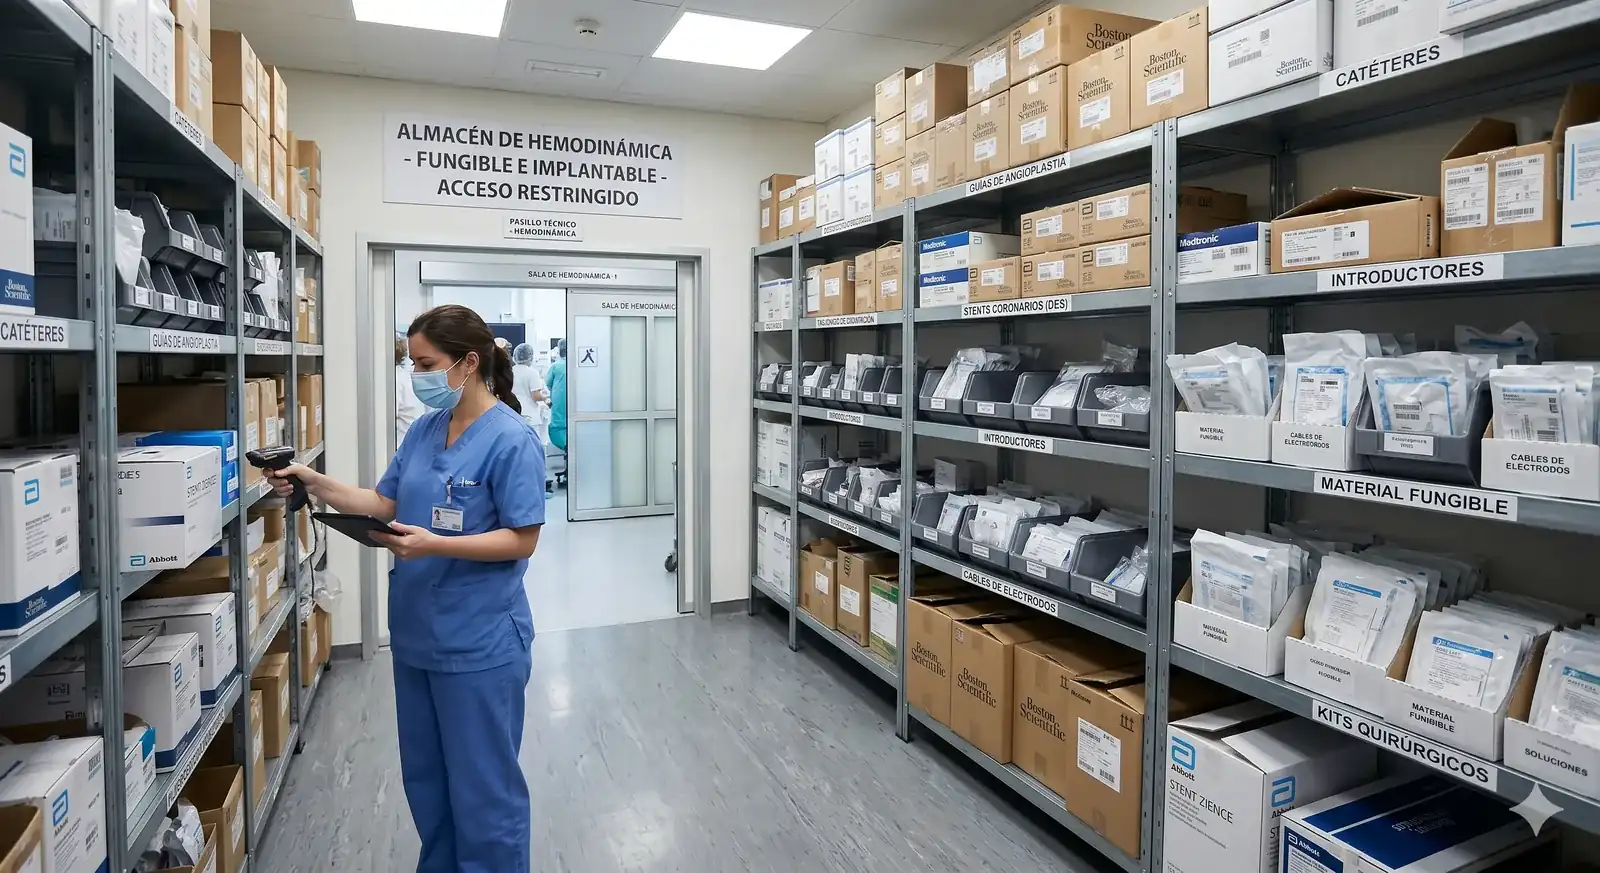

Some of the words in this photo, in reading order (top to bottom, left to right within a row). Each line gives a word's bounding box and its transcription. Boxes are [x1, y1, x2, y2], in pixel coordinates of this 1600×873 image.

[1143, 52, 1187, 78] Scientific
[1149, 49, 1177, 66] Boston
[1280, 57, 1303, 69] Boston
[1335, 44, 1441, 88] CATÉTERES
[1275, 59, 1313, 77] Scientific
[1077, 82, 1114, 102] Scientific
[1082, 76, 1106, 92] Boston
[1022, 99, 1042, 112] Boston
[397, 123, 493, 147] ALMACÉN
[499, 130, 523, 149] DE
[528, 133, 673, 161] HEMODINÁMICA
[417, 150, 513, 174] FUNGIBLE
[518, 158, 527, 175] E
[533, 159, 657, 184] IMPLANTABLE
[993, 175, 1004, 187] DE
[1005, 157, 1067, 183] ANGIOPLASTIA
[437, 178, 513, 200] ACCESO
[517, 184, 640, 207] RESTRINGIDO
[509, 218, 542, 227] PASILLO
[543, 218, 577, 228] TÉCNICO
[514, 228, 577, 237] HEMODINÁMICA
[528, 270, 546, 278] SALA
[1331, 260, 1485, 288] INTRODUCTORES
[630, 302, 676, 310] HEMODINÁMIC
[963, 304, 991, 317] STENTS
[992, 301, 1044, 314] CORONARIOS
[1045, 298, 1068, 312] (DES)
[0, 319, 65, 344] CATÉTERES
[173, 335, 181, 349] DE
[1199, 426, 1225, 434] MATERIAL
[1290, 432, 1314, 440] CABLES
[983, 433, 1046, 450] INTRODUCTORES
[1506, 462, 1570, 475] ELECTRODOS
[1510, 453, 1549, 464] CABLES
[1551, 456, 1565, 465] DE
[1321, 476, 1404, 501] MATERIAL
[1409, 488, 1508, 515] FUNGIBLE
[149, 555, 178, 563] Abbott
[963, 570, 991, 588] CABLES
[992, 579, 1003, 592] DE
[1003, 584, 1056, 614] ELECTRODOS
[916, 641, 938, 659] Boston
[911, 647, 946, 678] Scientific
[963, 668, 988, 691] Boston
[957, 674, 997, 709] Scientific
[1027, 697, 1056, 722] Boston
[1411, 702, 1456, 723] MATERIAL
[1019, 702, 1066, 742] Scientific
[1317, 705, 1353, 730] KITS
[1357, 720, 1490, 784] QUIRÚRGICOS
[1524, 747, 1588, 777] SOLUCIONES
[1170, 763, 1196, 782] Abbott
[1169, 779, 1198, 802] STENT
[1199, 795, 1234, 825] ZIENCE
